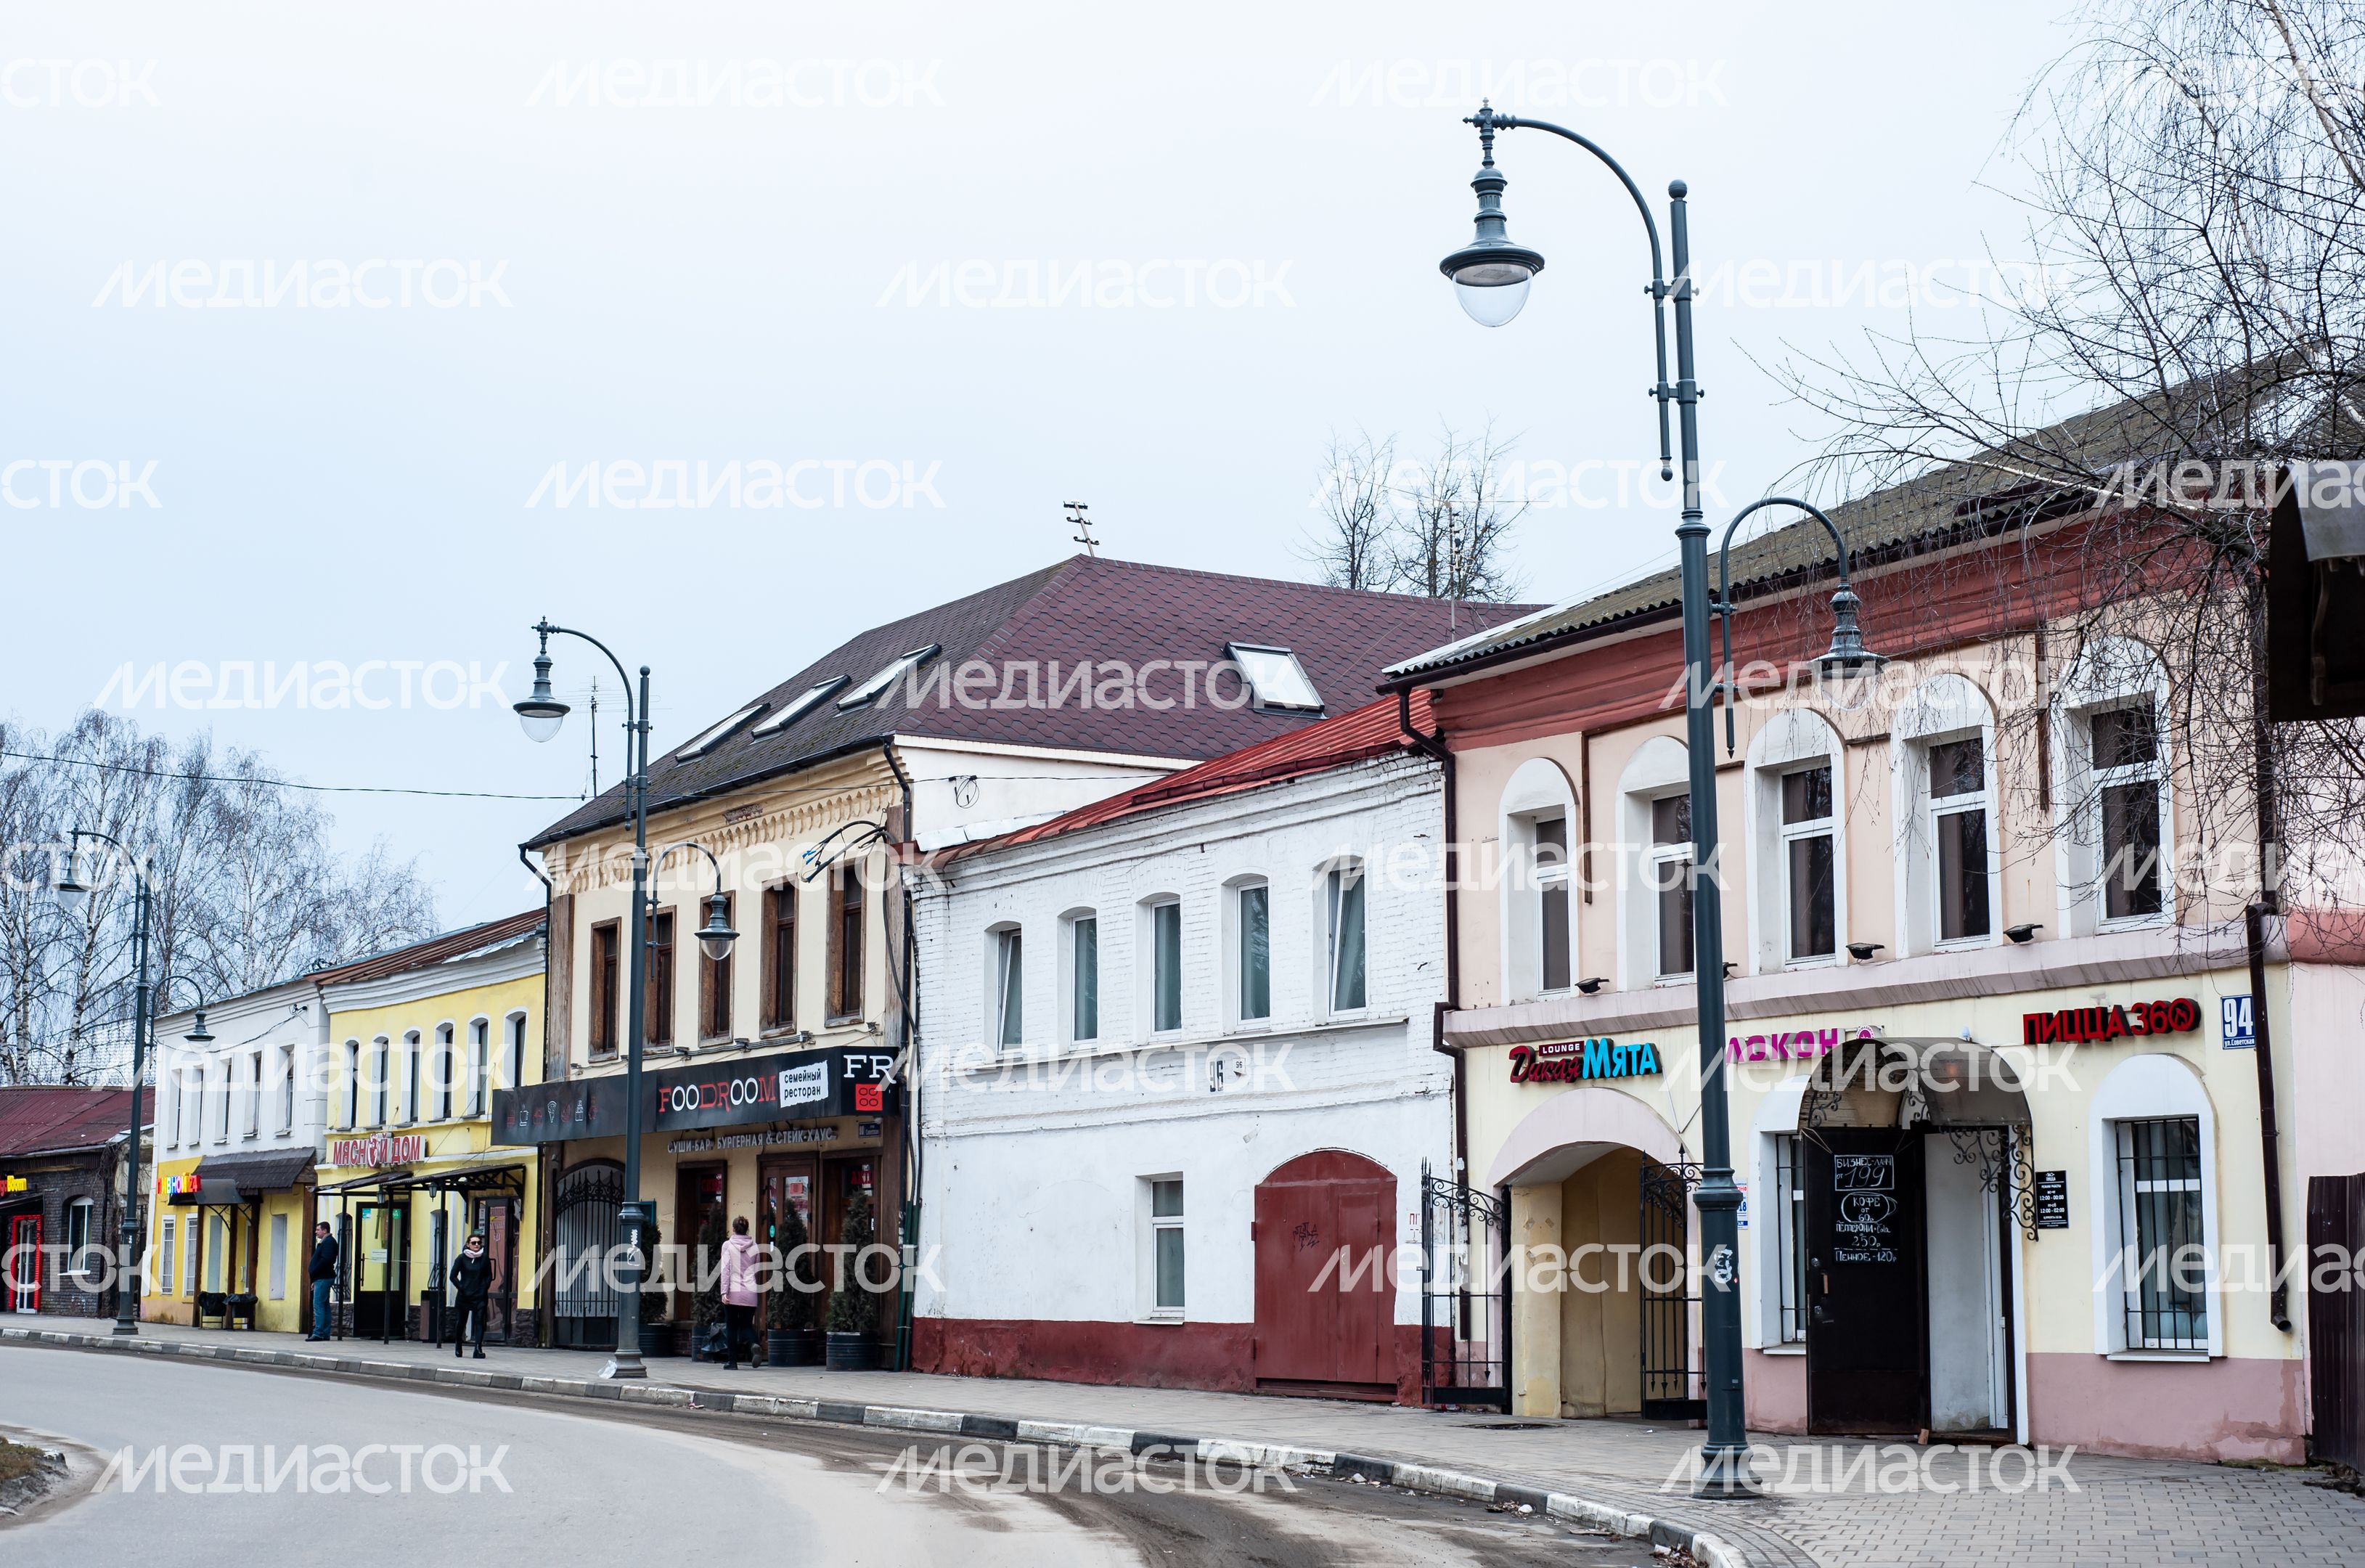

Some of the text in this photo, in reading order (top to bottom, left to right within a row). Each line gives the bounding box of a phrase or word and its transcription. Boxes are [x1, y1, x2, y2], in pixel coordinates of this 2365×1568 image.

[2223, 997, 2253, 1037] 94
[1543, 1043, 1580, 1054] LOUNGE
[1726, 1028, 1839, 1064] ЛОКОН
[784, 1068, 822, 1084] семейный
[844, 1055, 897, 1084] FR
[658, 1074, 777, 1114] FOODROOM
[784, 1087, 821, 1101] ресторан
[391, 1135, 421, 1165] ДОМ
[717, 1133, 763, 1150] БУРГЕРНАЯ
[766, 1130, 773, 1145] &
[775, 1127, 833, 1145] СТЕЙК-ХАУС
[157, 1172, 200, 1195] ПИВНОЙ 24
[1845, 1165, 1885, 1188] 199
[1853, 1197, 1881, 1207] КОФЕ
